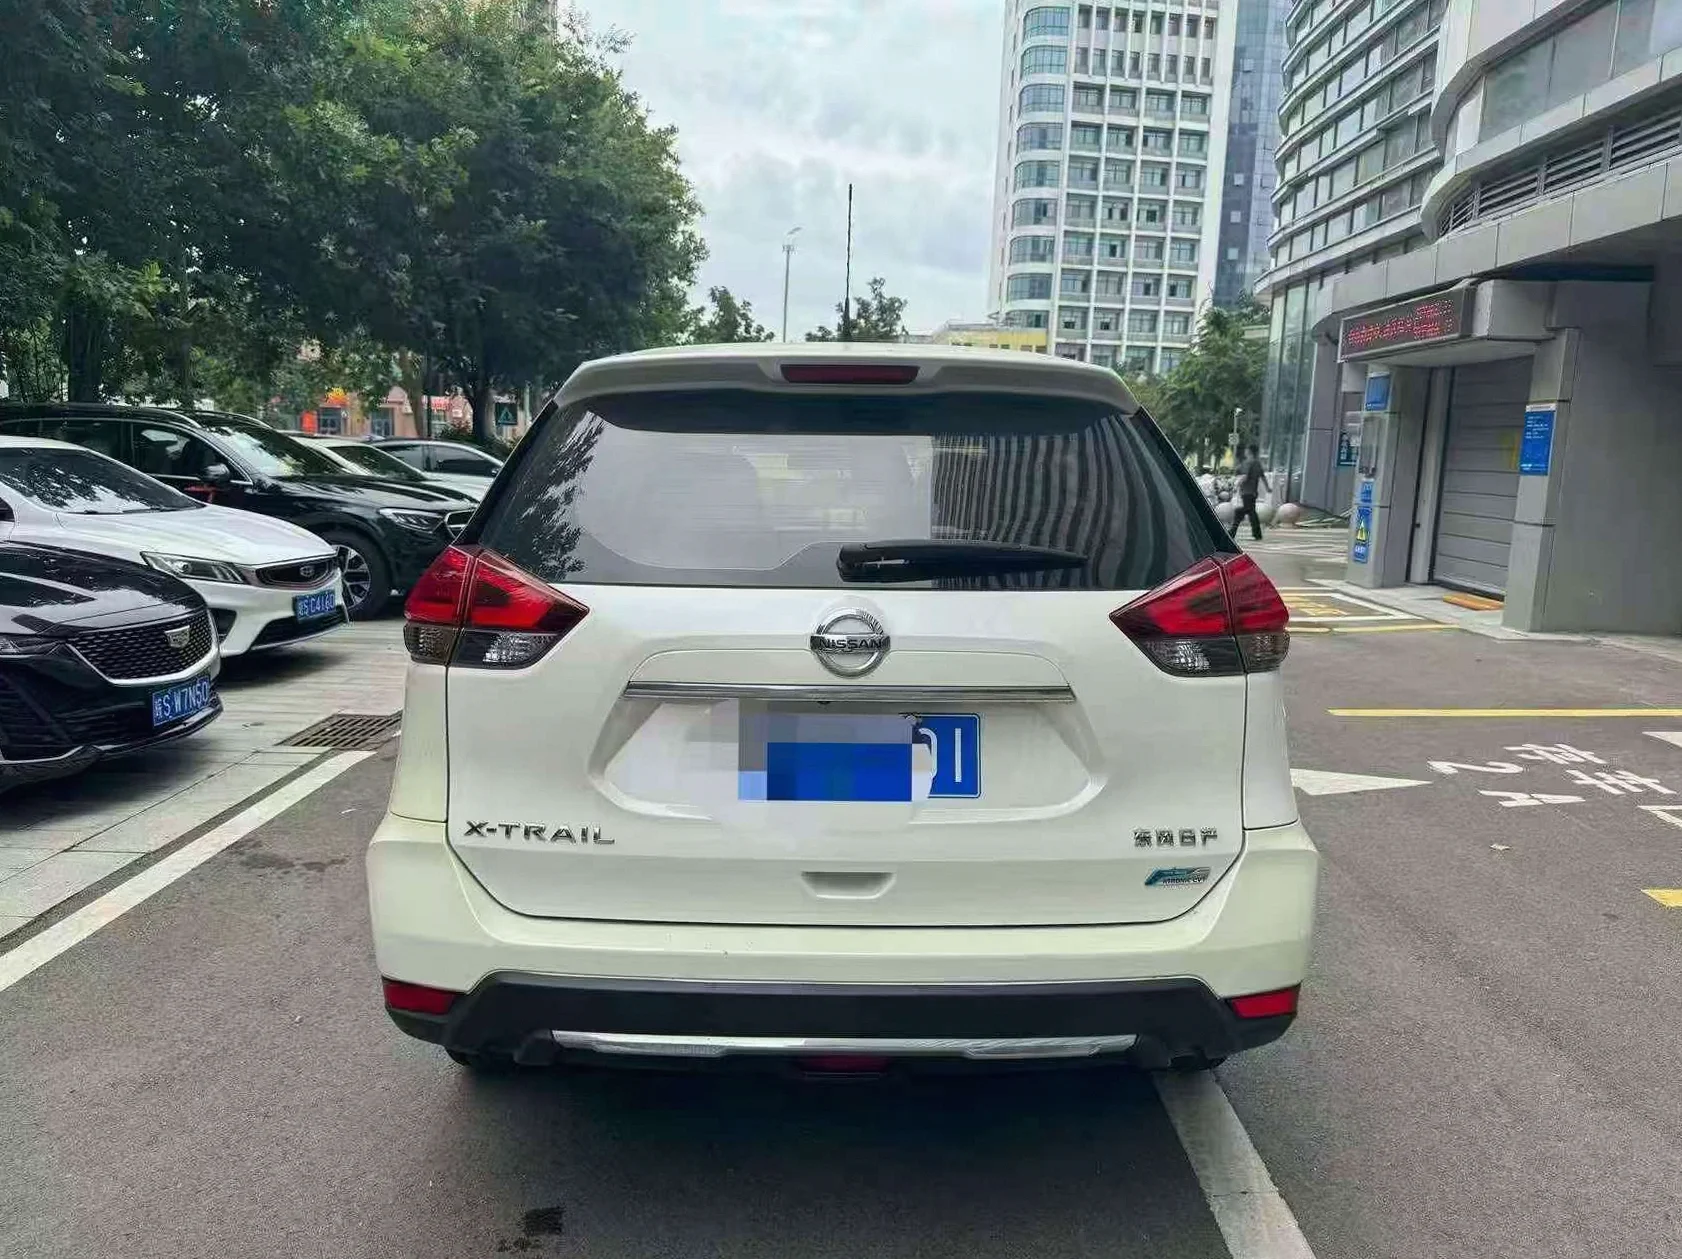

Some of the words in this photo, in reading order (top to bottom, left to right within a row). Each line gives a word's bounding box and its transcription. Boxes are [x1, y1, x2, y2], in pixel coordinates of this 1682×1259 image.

[820, 638, 882, 649] NISSAN
[464, 820, 615, 846] X-TRAIL
[1133, 827, 1218, 848] 东风日产
